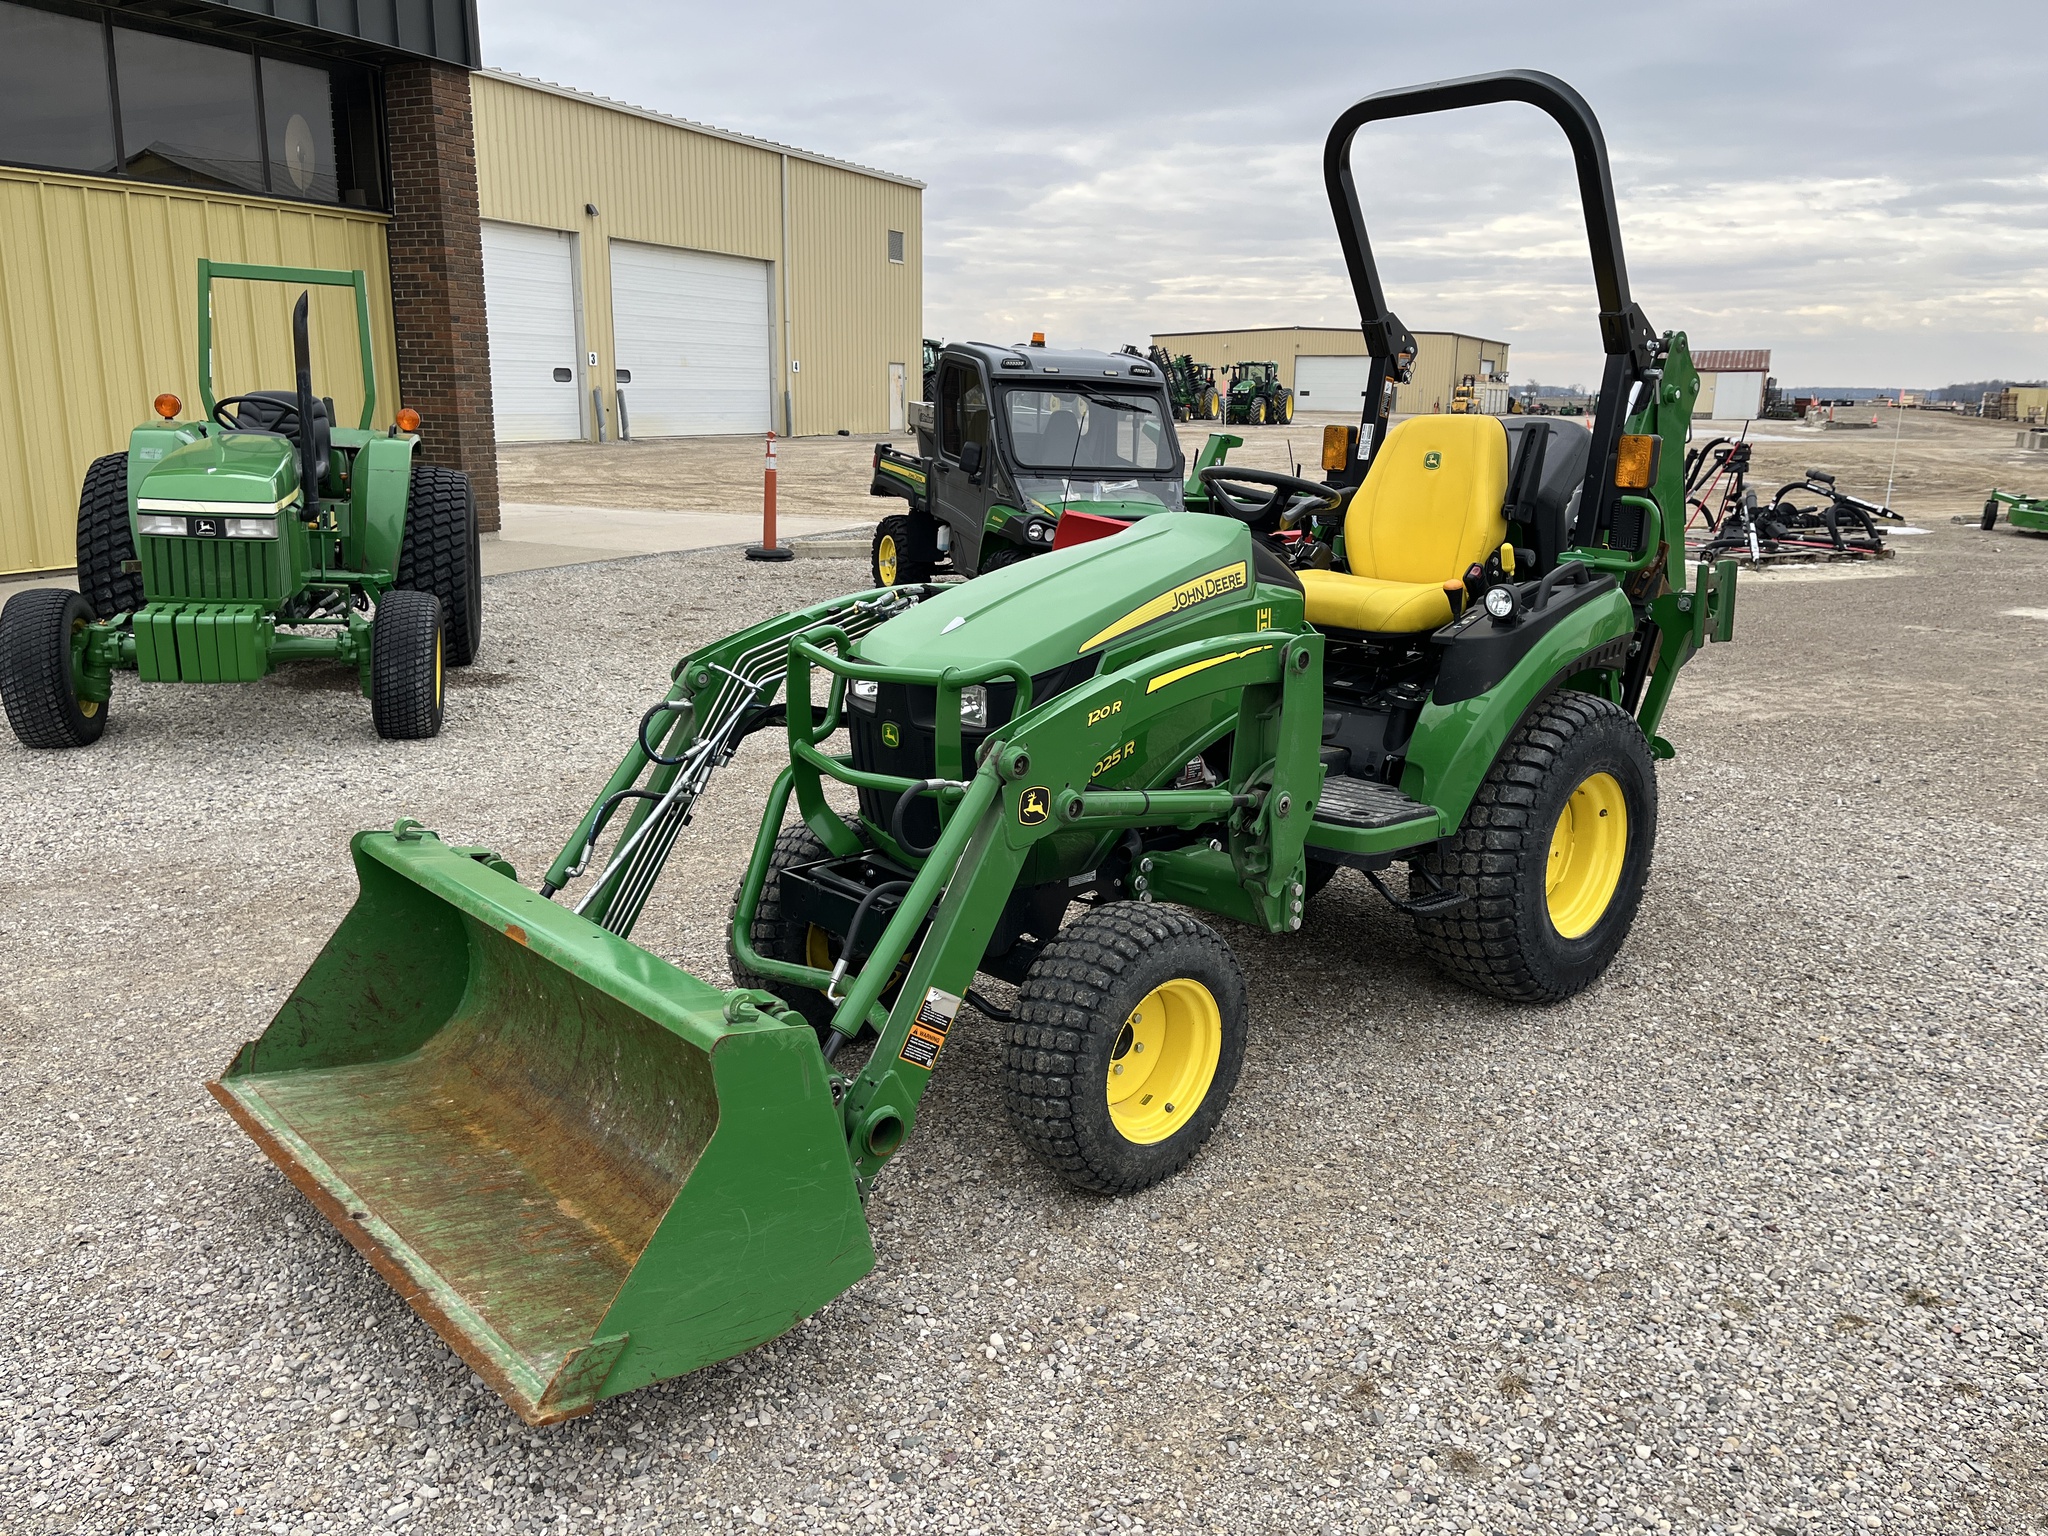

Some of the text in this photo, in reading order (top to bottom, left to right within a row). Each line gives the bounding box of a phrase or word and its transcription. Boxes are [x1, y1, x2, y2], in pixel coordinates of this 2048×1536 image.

[591, 354, 596, 364] 3
[1172, 572, 1243, 610] JOHN DEERE
[919, 1031, 940, 1043] WARNING
